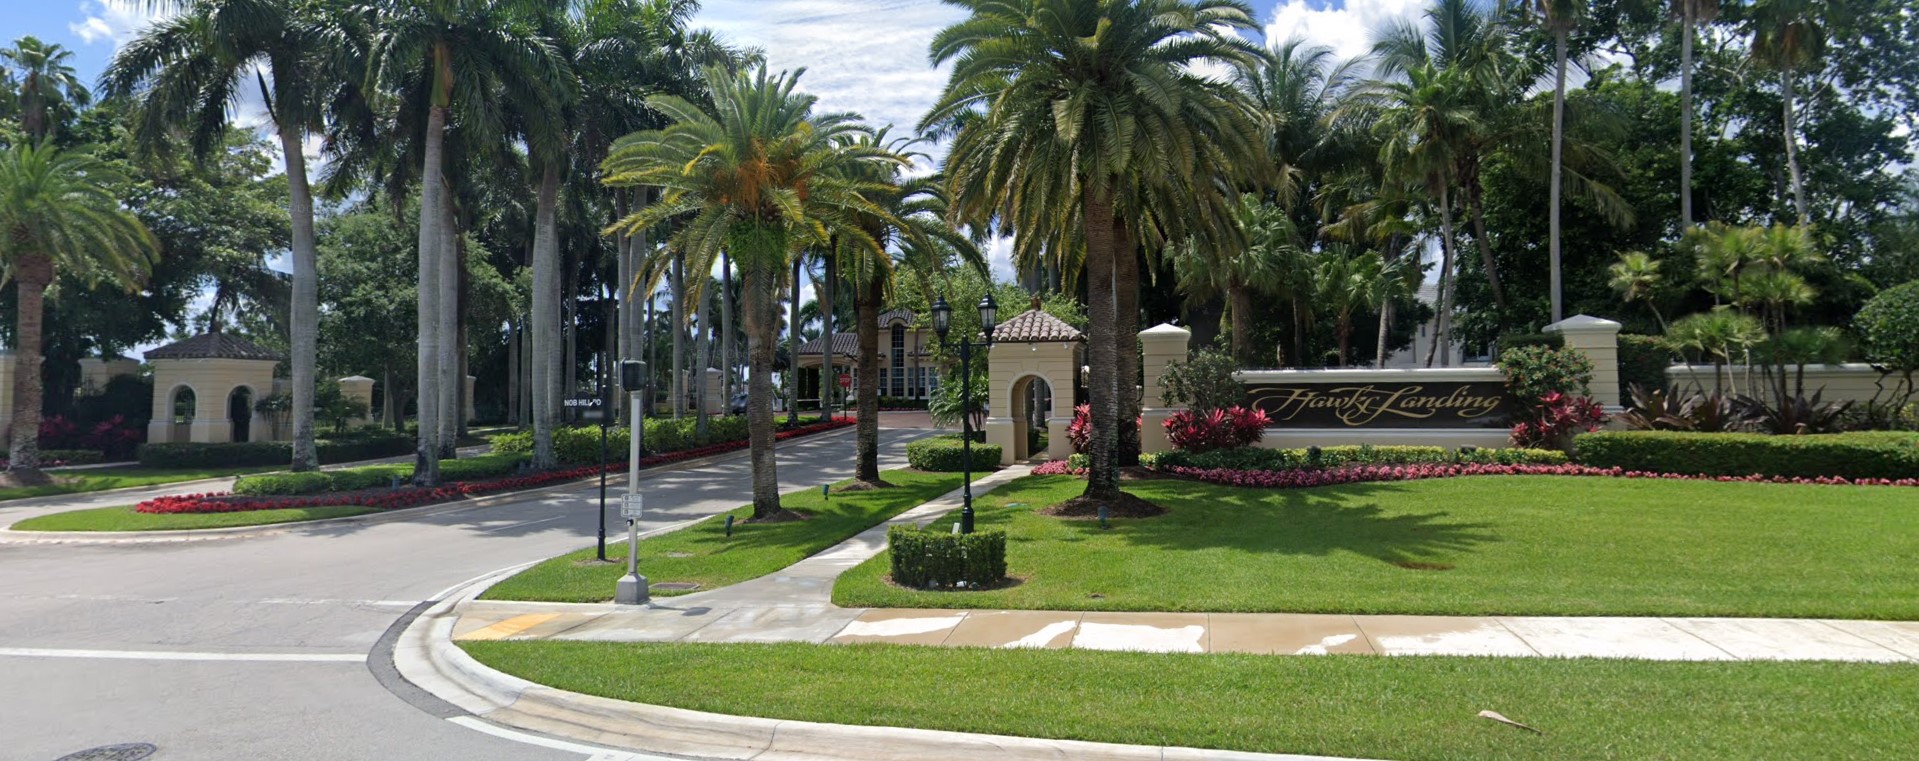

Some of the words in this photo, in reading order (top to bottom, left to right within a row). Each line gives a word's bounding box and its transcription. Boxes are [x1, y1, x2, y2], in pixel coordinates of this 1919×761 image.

[564, 399, 578, 407] NOB
[578, 398, 591, 406] HILL
[1247, 384, 1379, 420] Hawks
[1343, 385, 1501, 425] Landing
